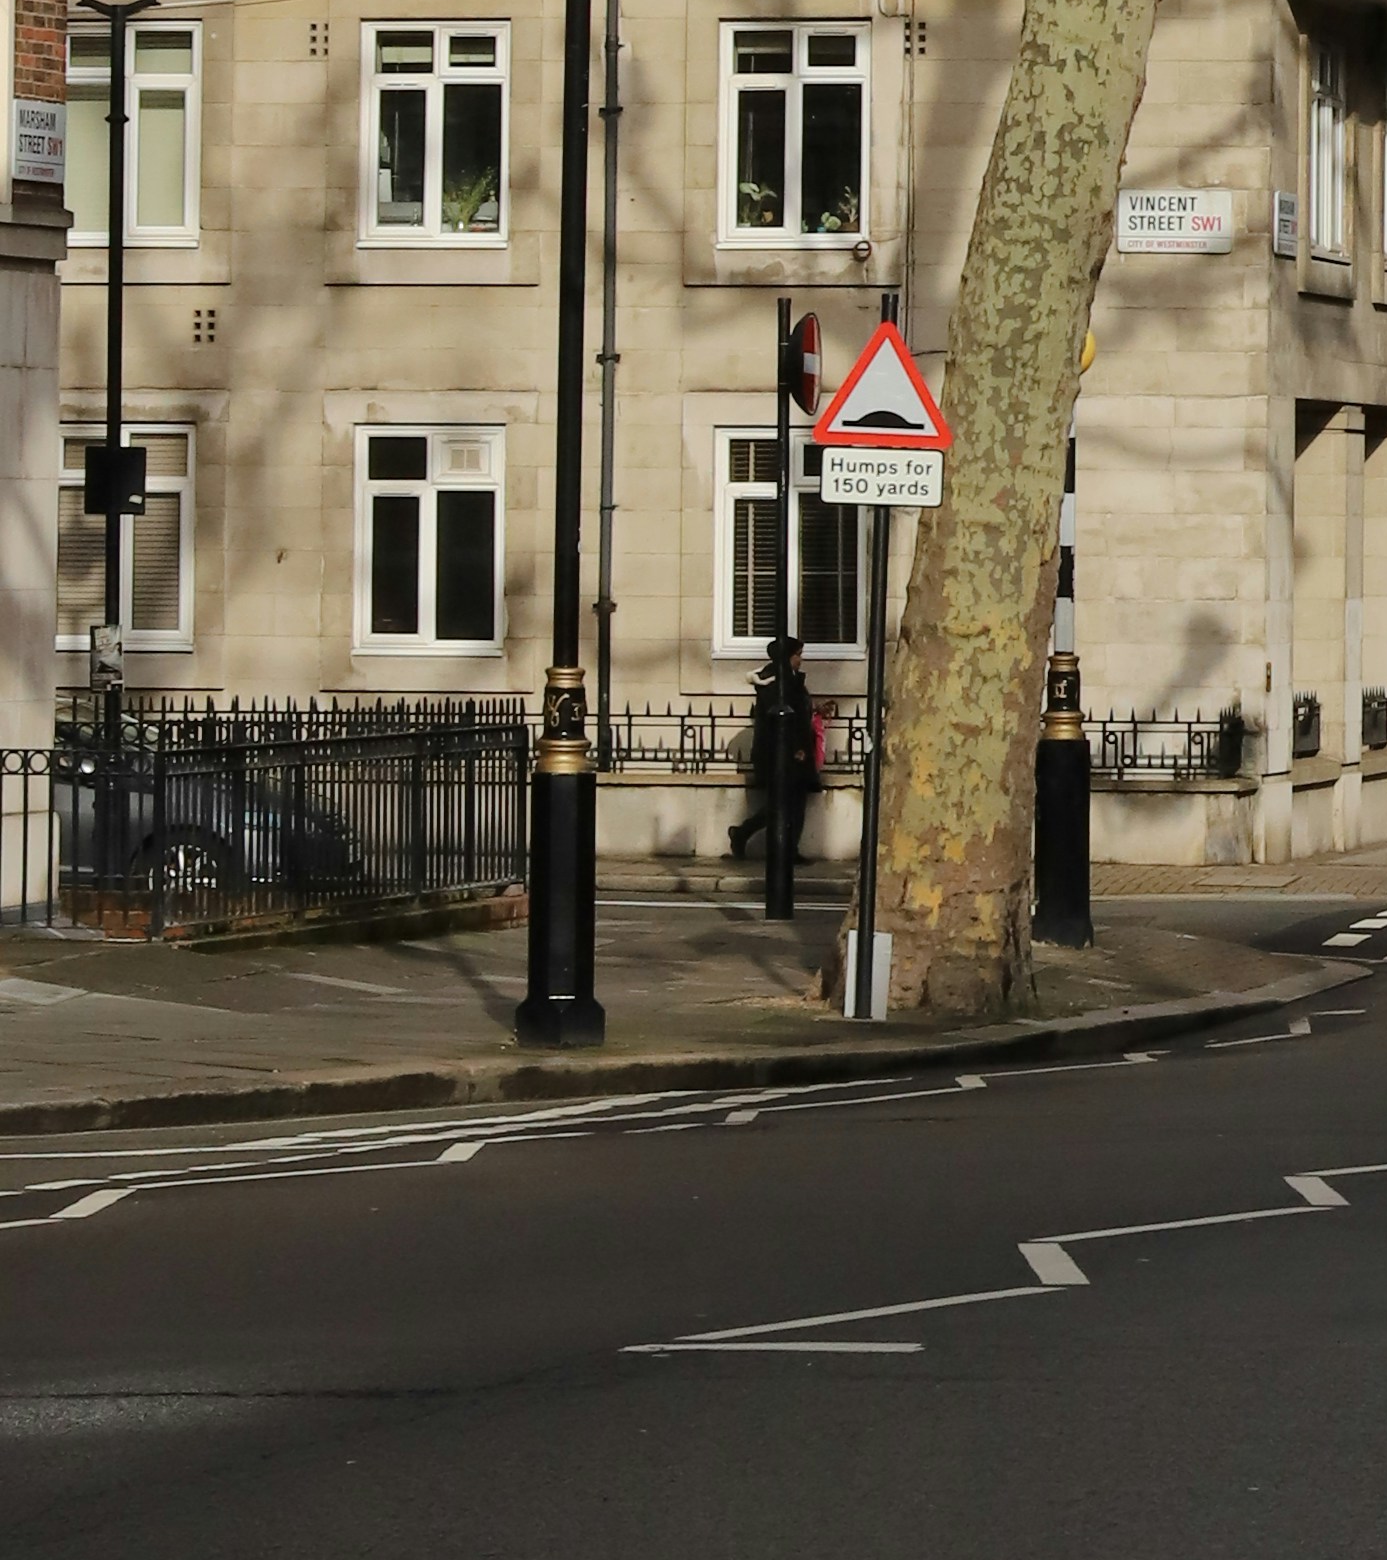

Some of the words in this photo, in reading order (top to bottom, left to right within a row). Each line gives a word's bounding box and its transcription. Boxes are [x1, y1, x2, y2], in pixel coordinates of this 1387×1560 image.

[19, 109, 56, 131] MARSHAM
[19, 134, 46, 155] STREET
[47, 137, 63, 156] SW1
[1129, 195, 1198, 212] VINCENT
[1128, 215, 1185, 231] STREET
[1191, 216, 1222, 232] SW1
[1127, 240, 1143, 249] CITY
[830, 457, 898, 476] Humps
[906, 460, 933, 475] for
[833, 477, 868, 493] 150
[876, 481, 929, 497] yards
